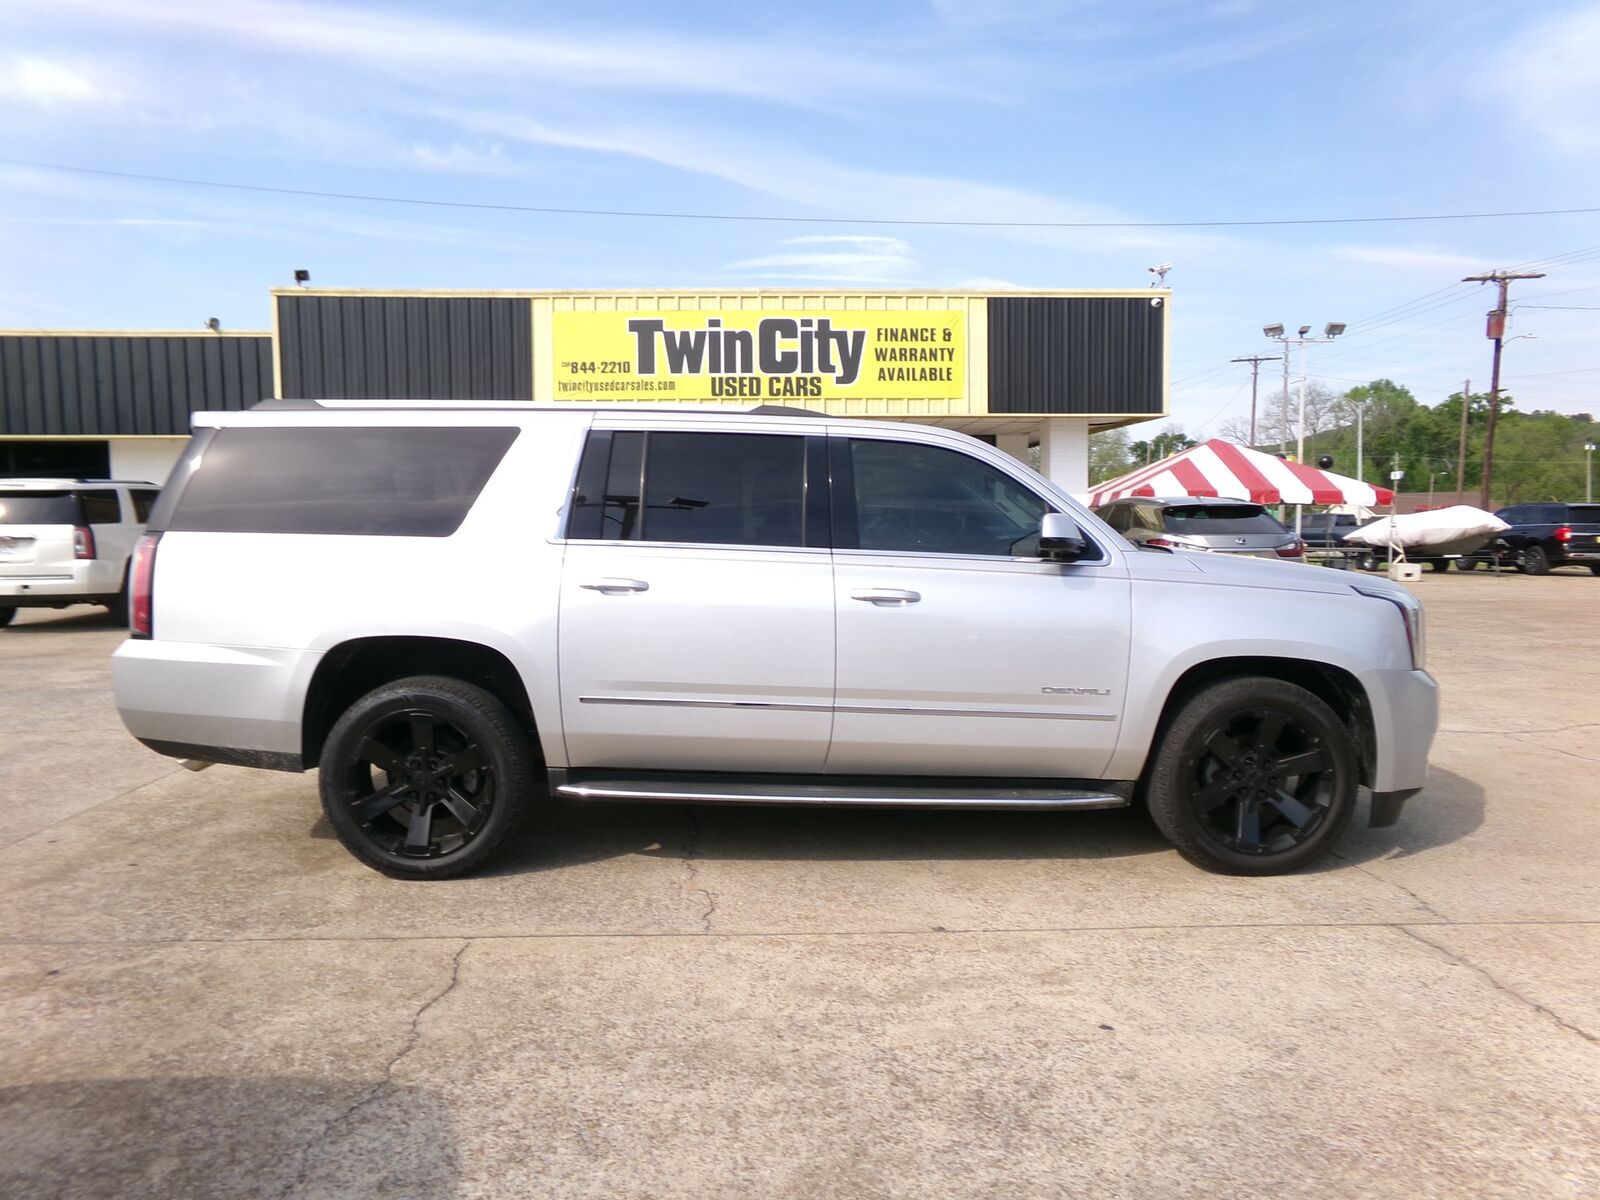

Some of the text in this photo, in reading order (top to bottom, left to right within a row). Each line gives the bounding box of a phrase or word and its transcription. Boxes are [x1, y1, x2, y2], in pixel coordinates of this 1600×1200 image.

[877, 327, 952, 342] FINANCE &
[874, 347, 955, 362] WARRANTY
[878, 367, 953, 381] AVAILABLE
[558, 380, 676, 393] twincityusedcarsales.com
[711, 376, 822, 397] USED CARS
[1041, 686, 1111, 696] DENALI
